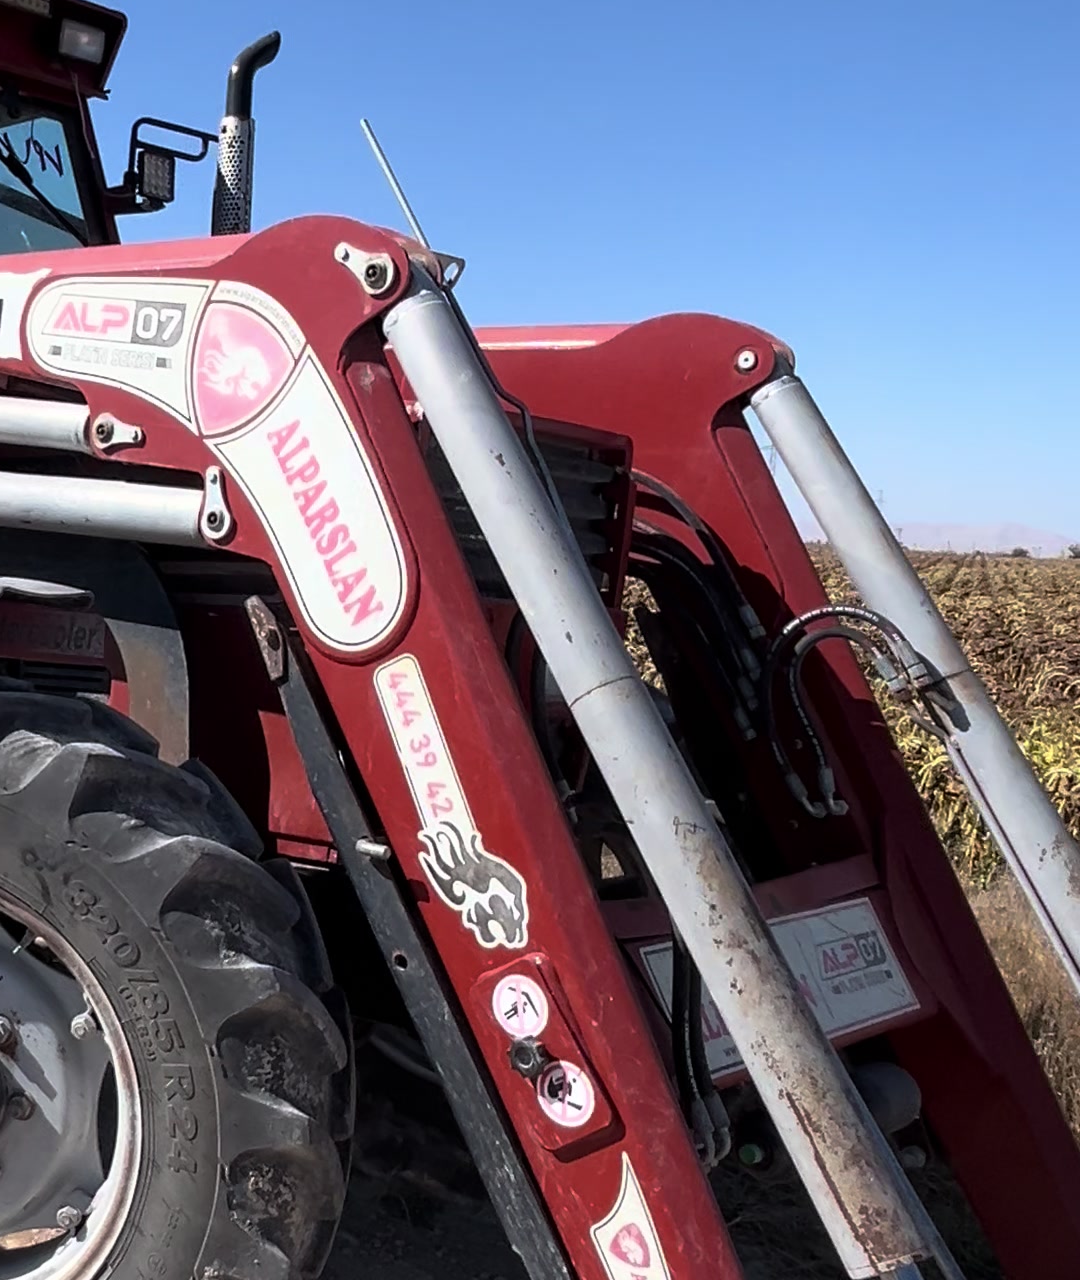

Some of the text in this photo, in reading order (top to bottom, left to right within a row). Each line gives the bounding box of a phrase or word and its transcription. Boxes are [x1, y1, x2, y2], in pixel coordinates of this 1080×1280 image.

[52, 300, 183, 341] ALP 07
[266, 418, 385, 627] ALPARSLAN
[388, 672, 454, 818] 444 39 42
[821, 939, 860, 975] ALP
